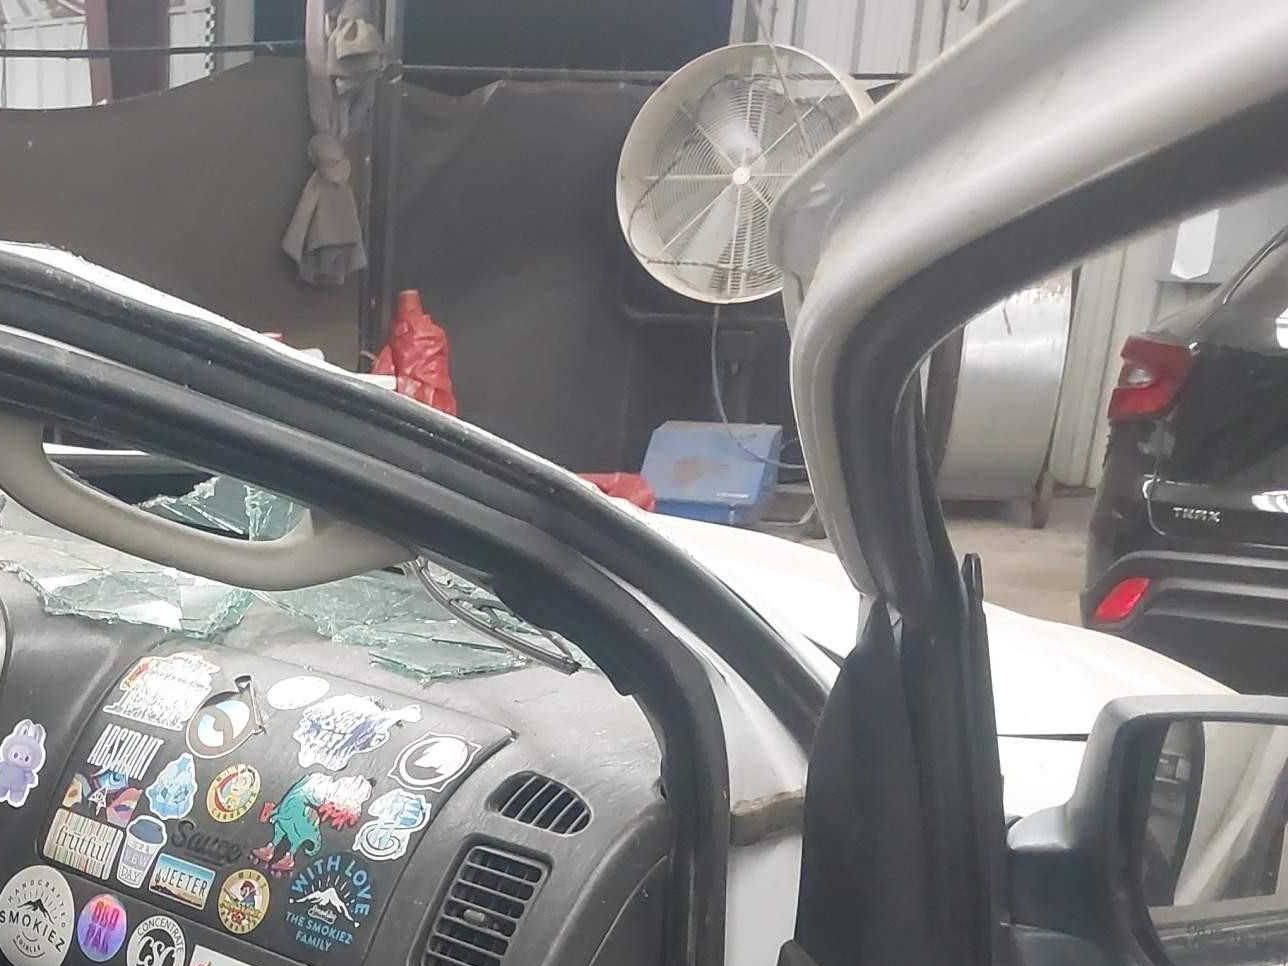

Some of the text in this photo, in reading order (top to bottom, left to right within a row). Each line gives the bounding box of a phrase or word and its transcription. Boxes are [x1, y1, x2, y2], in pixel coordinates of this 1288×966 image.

[1172, 506, 1221, 523] TRAX
[170, 819, 243, 865] Sauce
[120, 866, 142, 883] DAY
[161, 866, 209, 896] JEETER
[292, 854, 341, 894] WITH
[344, 860, 373, 916] LOVE
[7, 879, 67, 928] HANDCRAFTED
[0, 909, 67, 953] SMOKIEZ
[137, 917, 185, 953] CONCENTRATE
[285, 911, 304, 927] THE
[307, 919, 353, 945] SMOKIEZ
[295, 930, 333, 952] FAMILY
